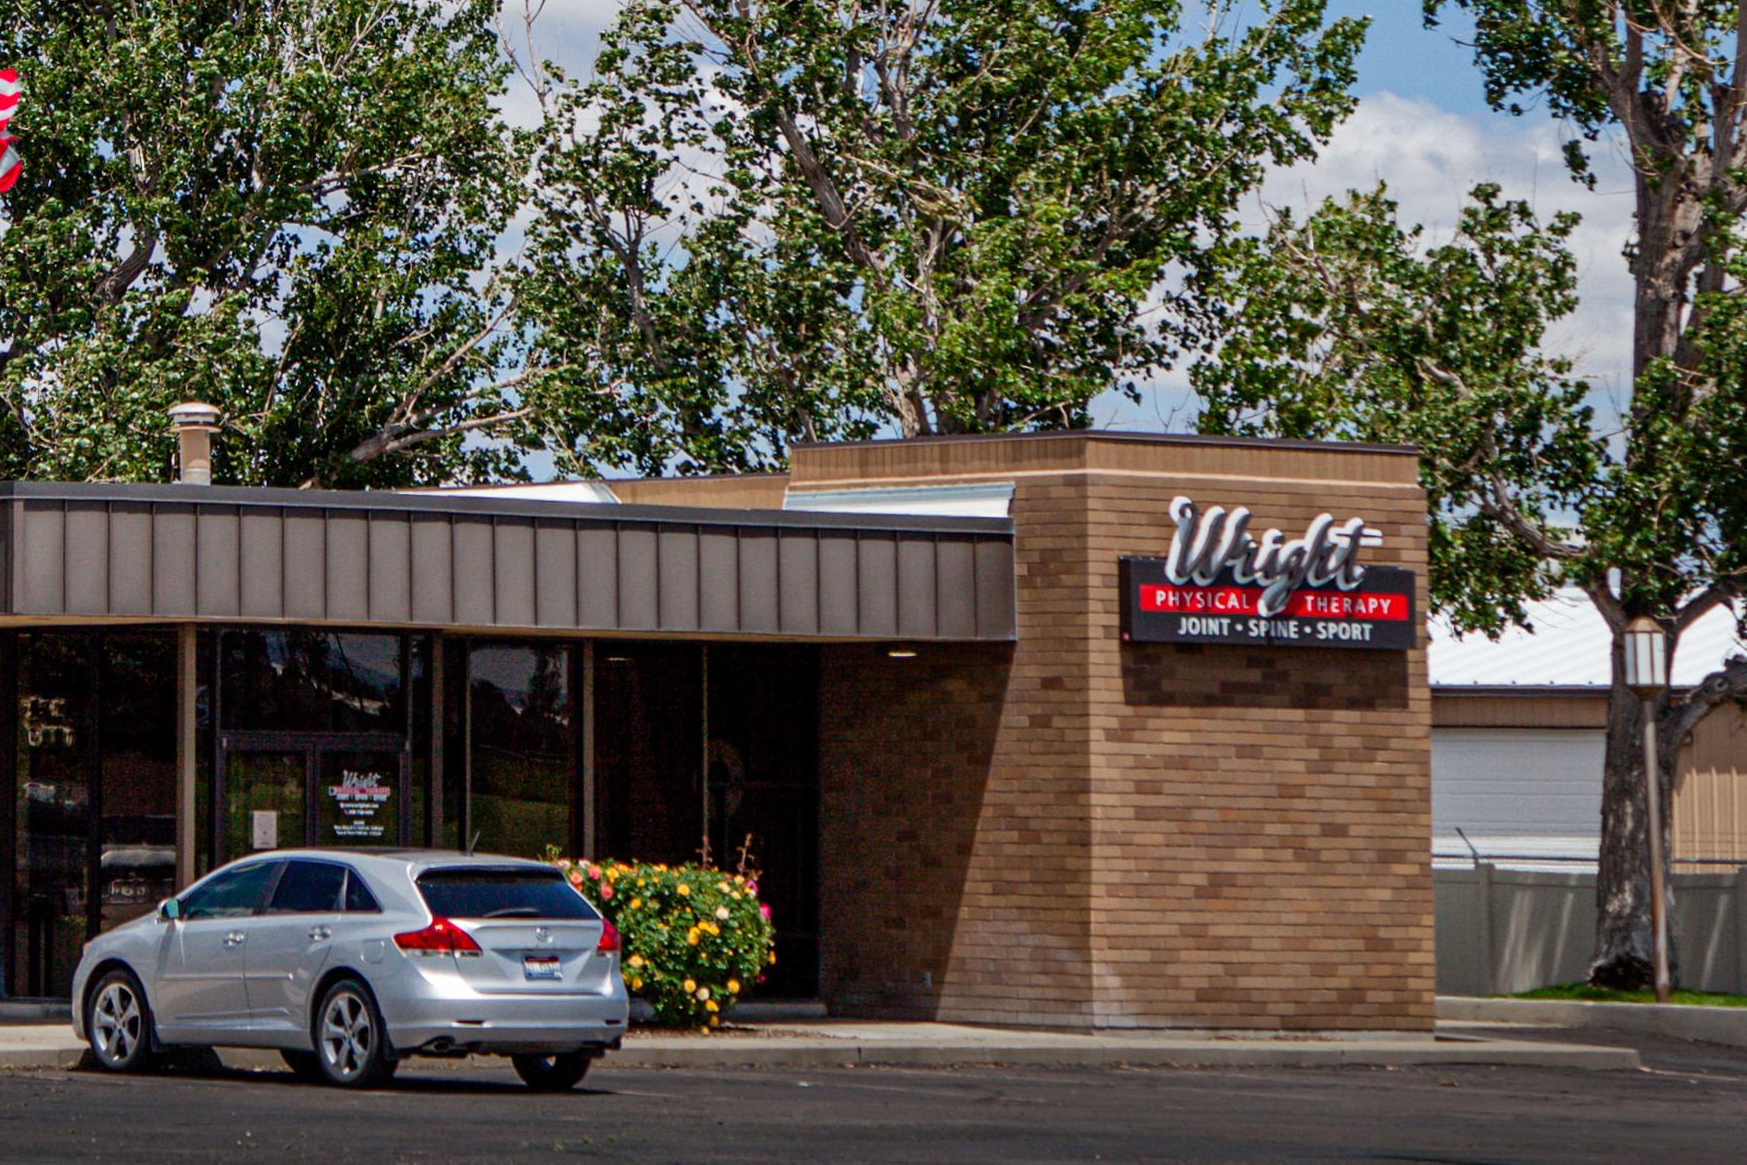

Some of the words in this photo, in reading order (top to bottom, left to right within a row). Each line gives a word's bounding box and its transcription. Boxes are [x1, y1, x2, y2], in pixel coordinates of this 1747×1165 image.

[1164, 495, 1383, 618] Wright
[1155, 589, 1251, 610] PHYSICAL
[1304, 595, 1392, 615] THERAPY
[1178, 617, 1231, 636] JOINT
[1248, 619, 1299, 639] SPINE
[1316, 622, 1373, 641] SPORT
